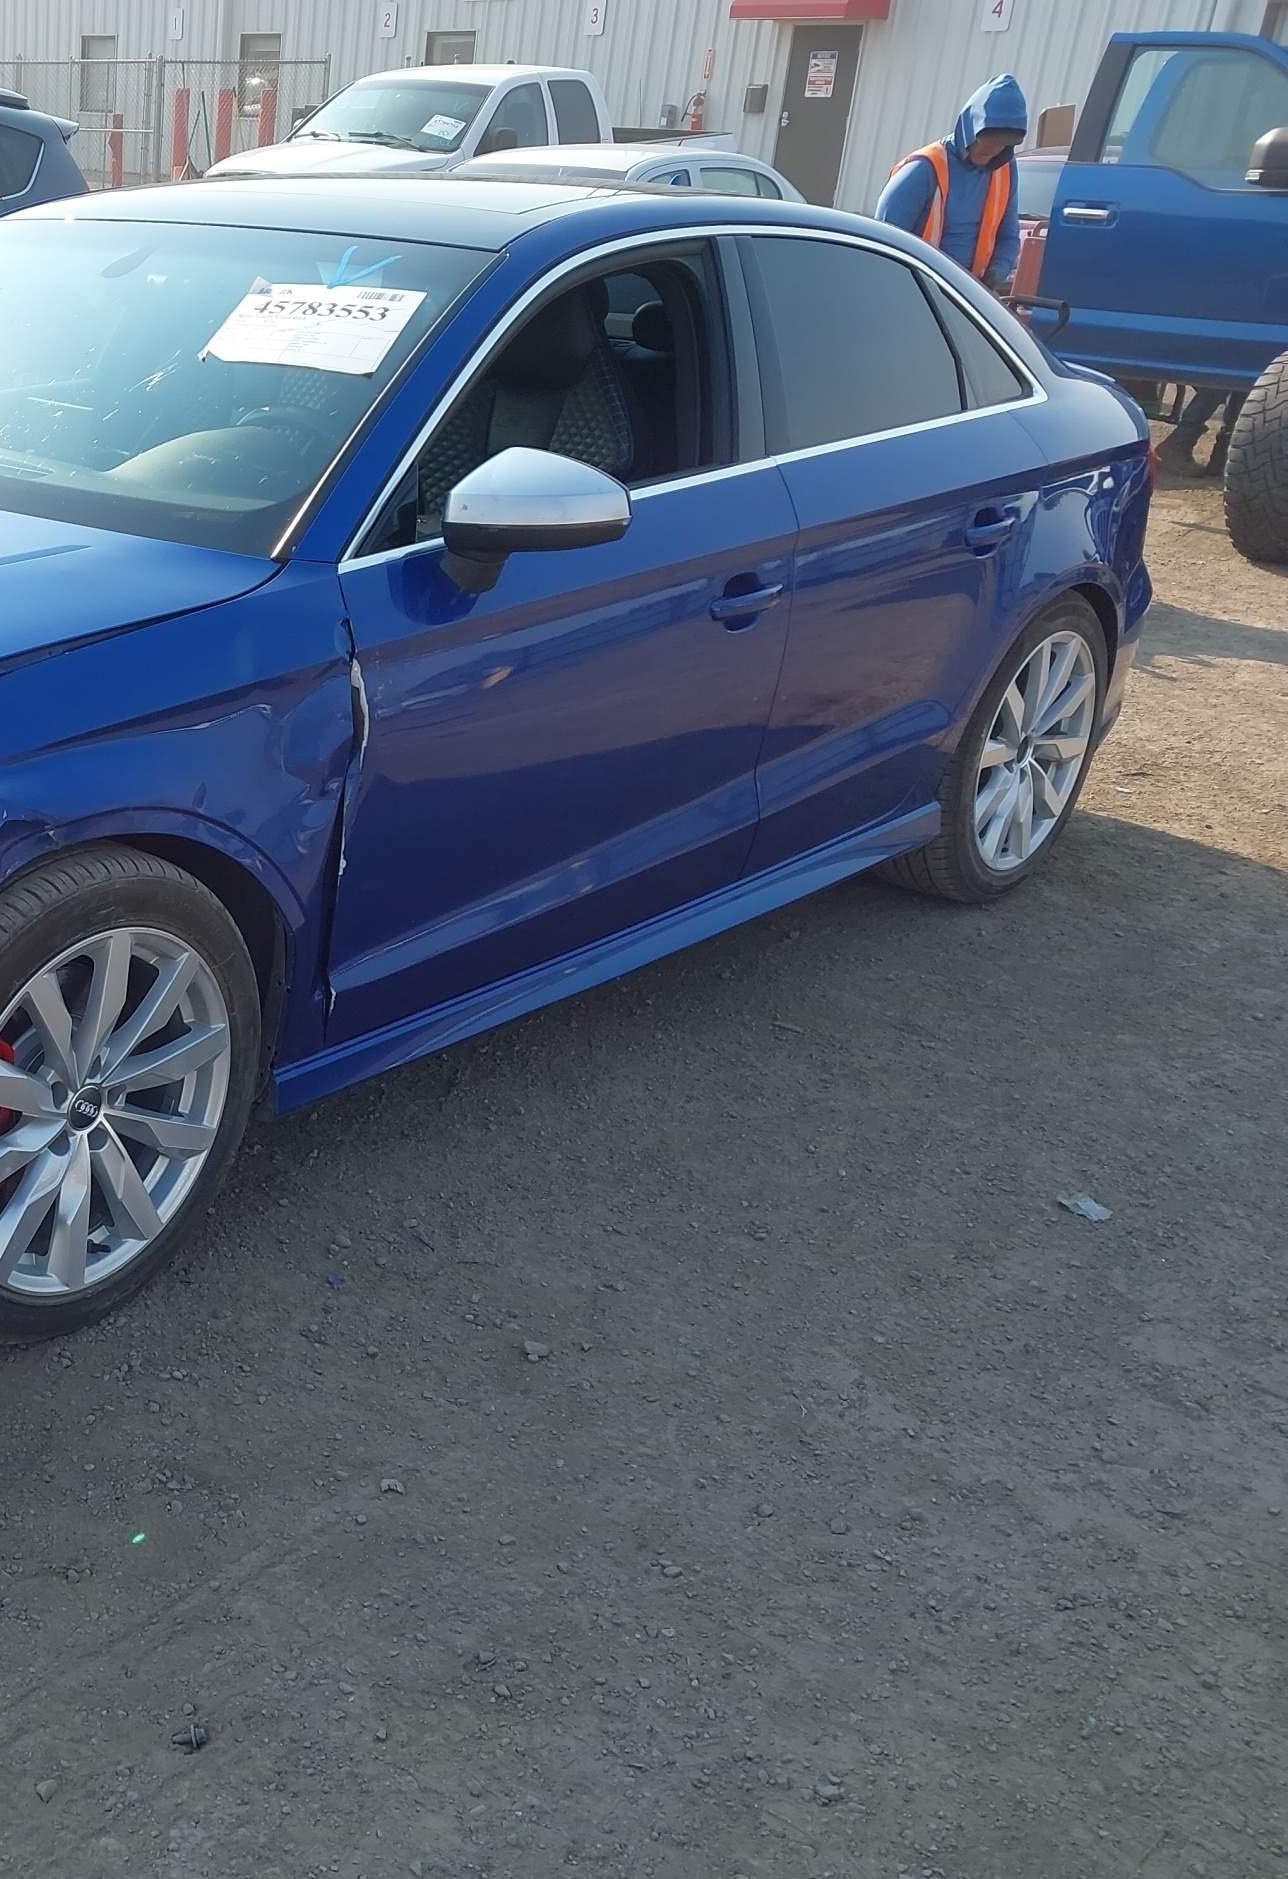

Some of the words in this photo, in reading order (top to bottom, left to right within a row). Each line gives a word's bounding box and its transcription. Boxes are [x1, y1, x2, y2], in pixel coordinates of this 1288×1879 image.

[591, 7, 599, 24] 3
[992, 0, 1004, 18] 4
[384, 12, 391, 28] 2
[254, 300, 390, 321] 45783553
